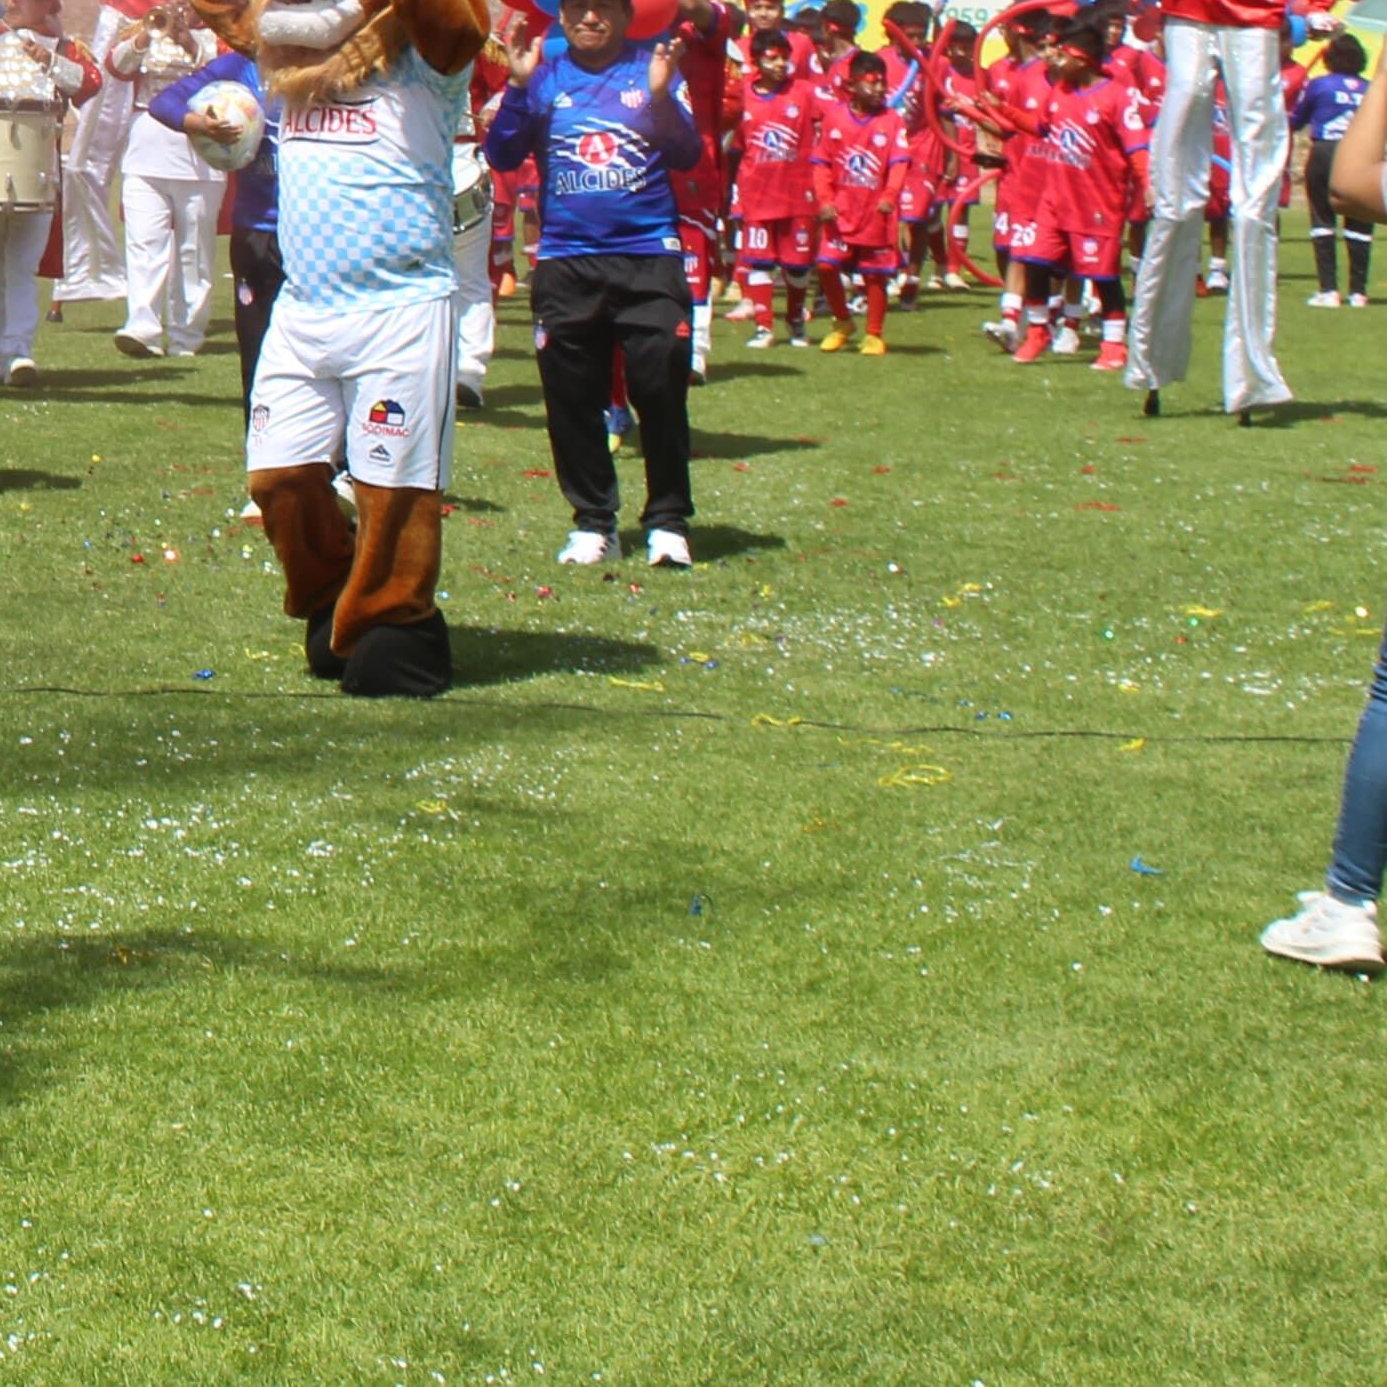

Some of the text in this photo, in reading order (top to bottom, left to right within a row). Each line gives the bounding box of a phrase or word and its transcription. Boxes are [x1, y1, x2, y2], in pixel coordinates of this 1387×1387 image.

[284, 108, 377, 135] ALCIDES
[584, 134, 611, 162] A
[555, 166, 647, 196] ALCIDES
[747, 226, 769, 250] 10
[363, 422, 411, 438] SODIMAC
